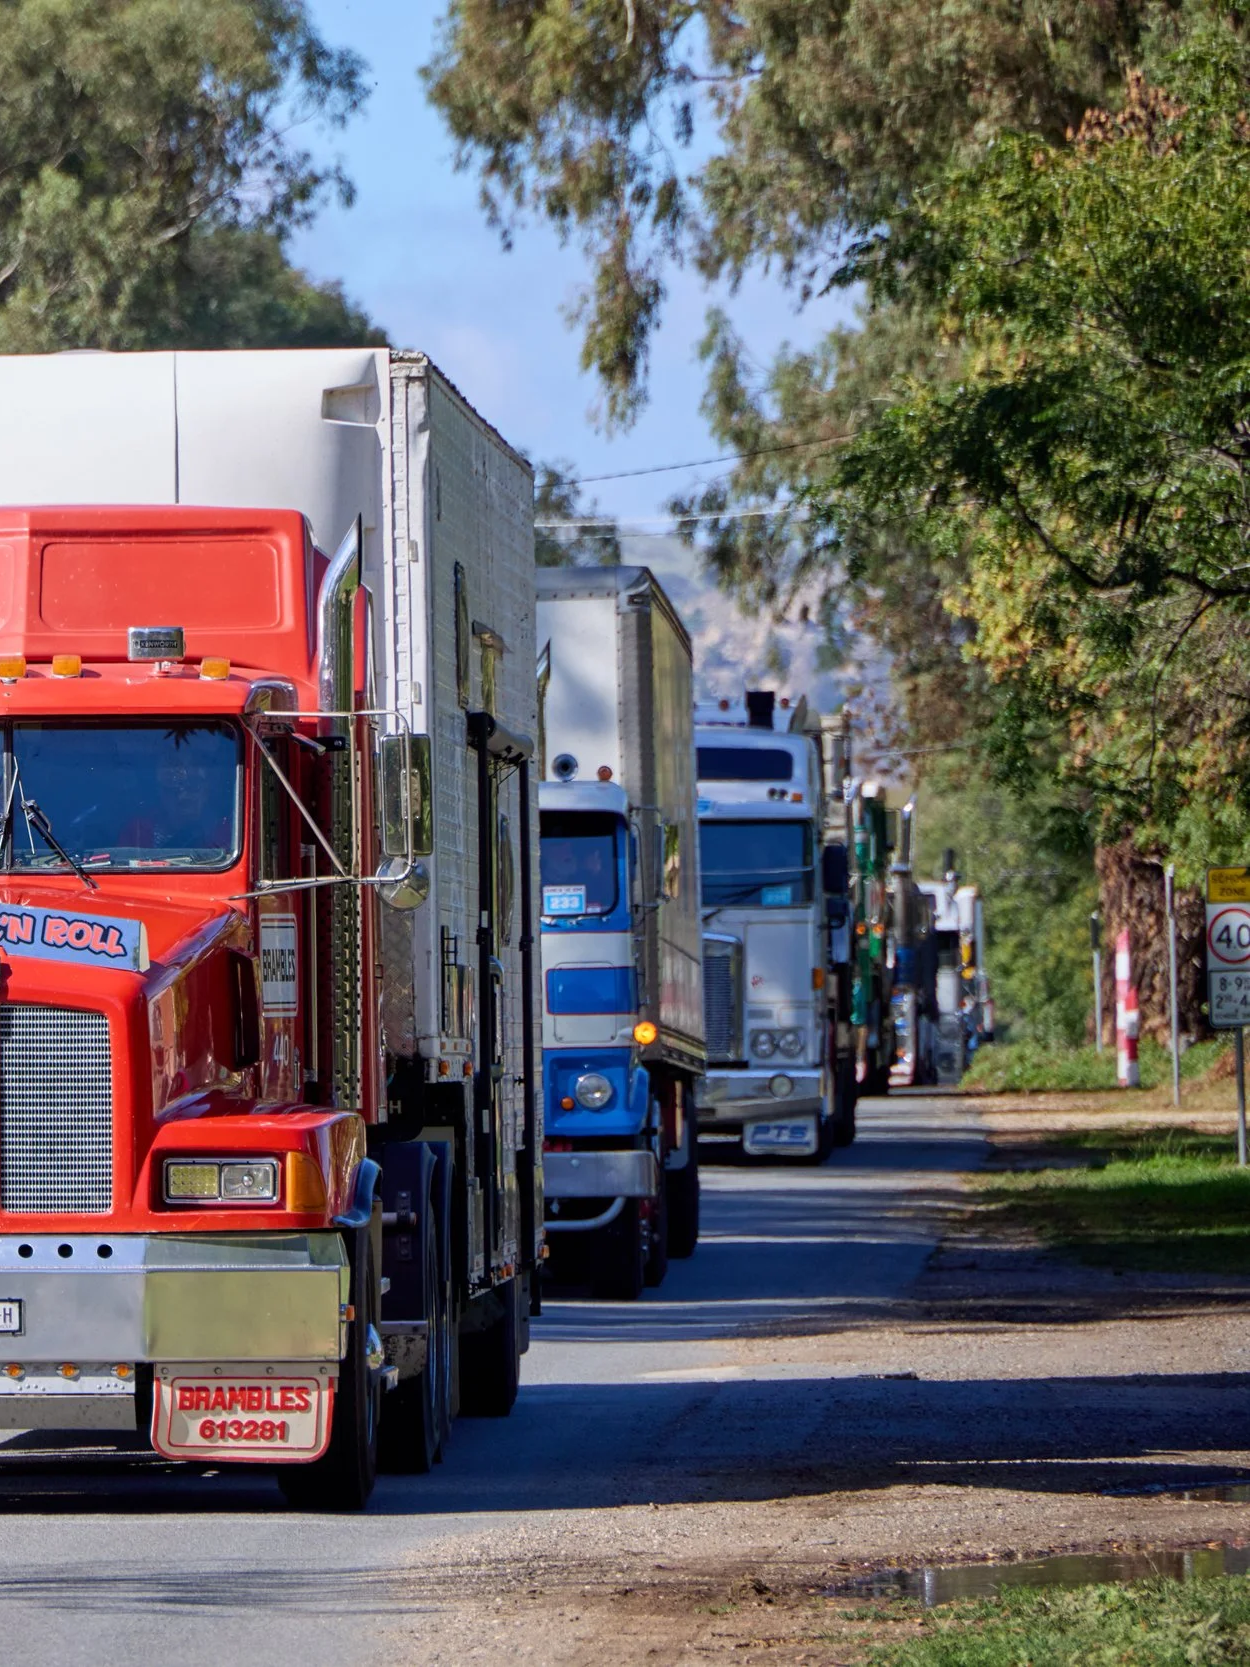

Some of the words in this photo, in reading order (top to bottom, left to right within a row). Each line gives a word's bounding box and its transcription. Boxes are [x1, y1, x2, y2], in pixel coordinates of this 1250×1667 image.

[140, 640, 177, 648] KENWORTH
[550, 897, 579, 909] 233
[1220, 887, 1246, 896] ZONE
[41, 914, 127, 957] ROLL
[1216, 924, 1250, 949] 40
[262, 949, 295, 982] BRAMBLES
[273, 1035, 289, 1066] 440
[178, 1386, 312, 1412] BRAMBLES
[199, 1419, 287, 1441] 613281
